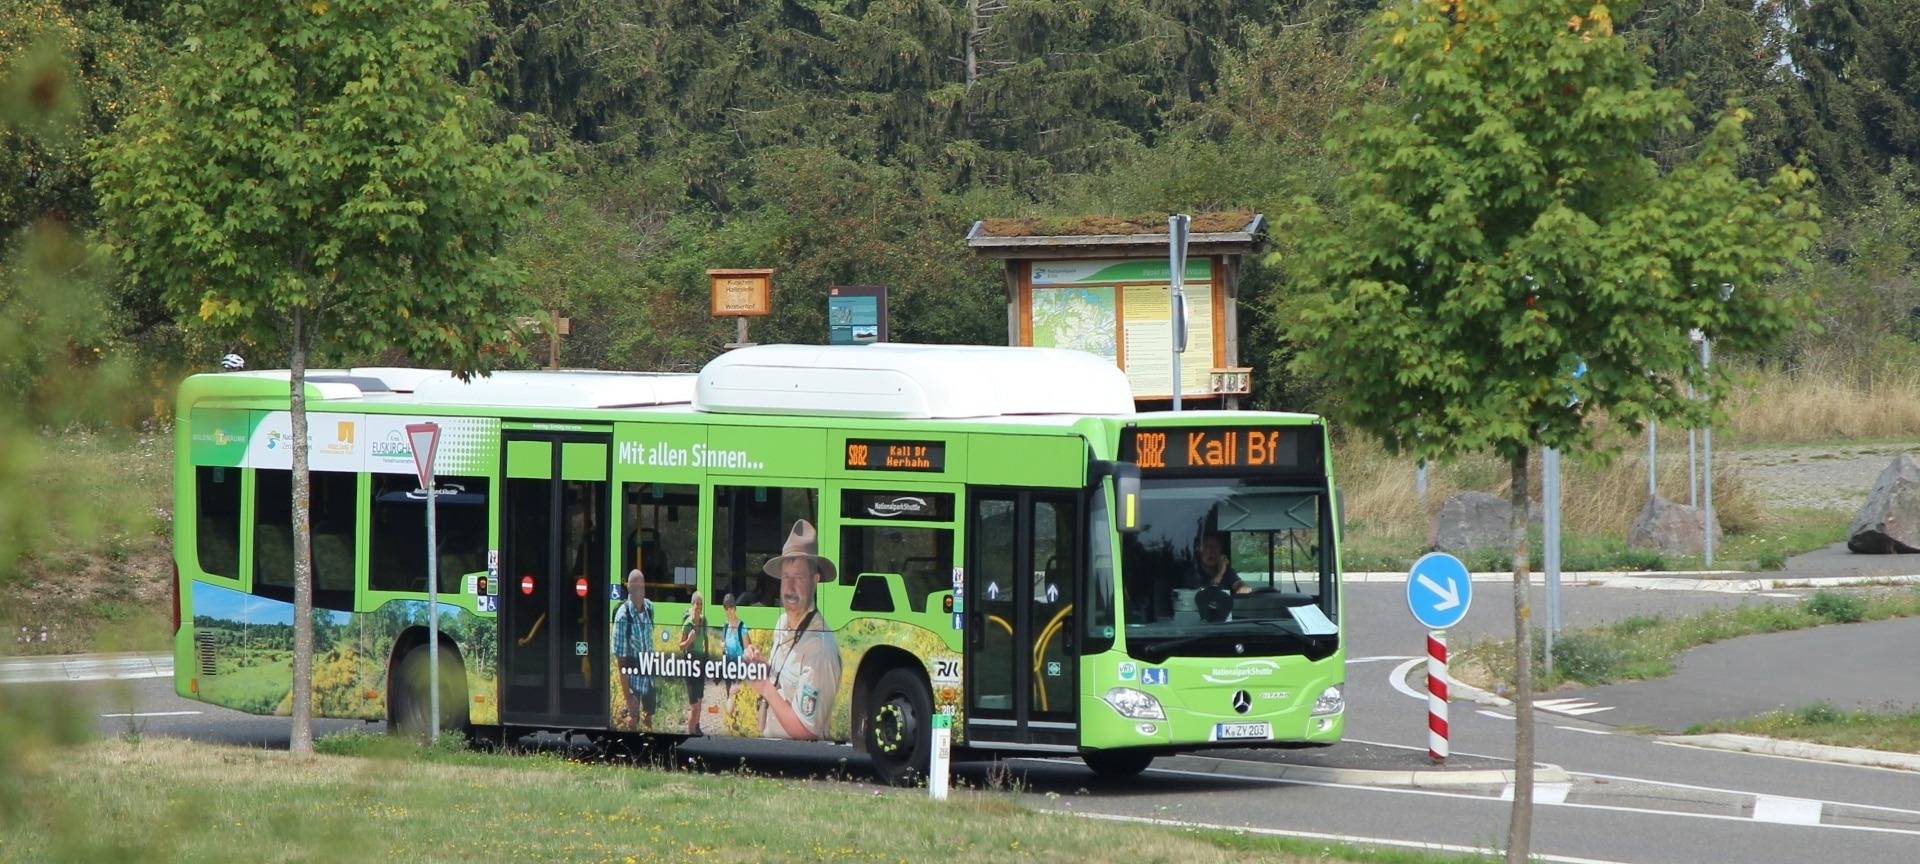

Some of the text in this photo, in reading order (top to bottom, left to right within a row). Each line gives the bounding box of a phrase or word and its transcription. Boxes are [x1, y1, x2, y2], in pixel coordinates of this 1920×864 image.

[618, 441, 764, 470] Mit allen Sinnen...
[889, 445, 927, 458] Kall Bf
[1188, 432, 1237, 465] Kall
[1247, 431, 1279, 464] Bf
[887, 456, 930, 468] Herhahn
[704, 656, 769, 681] erleben
